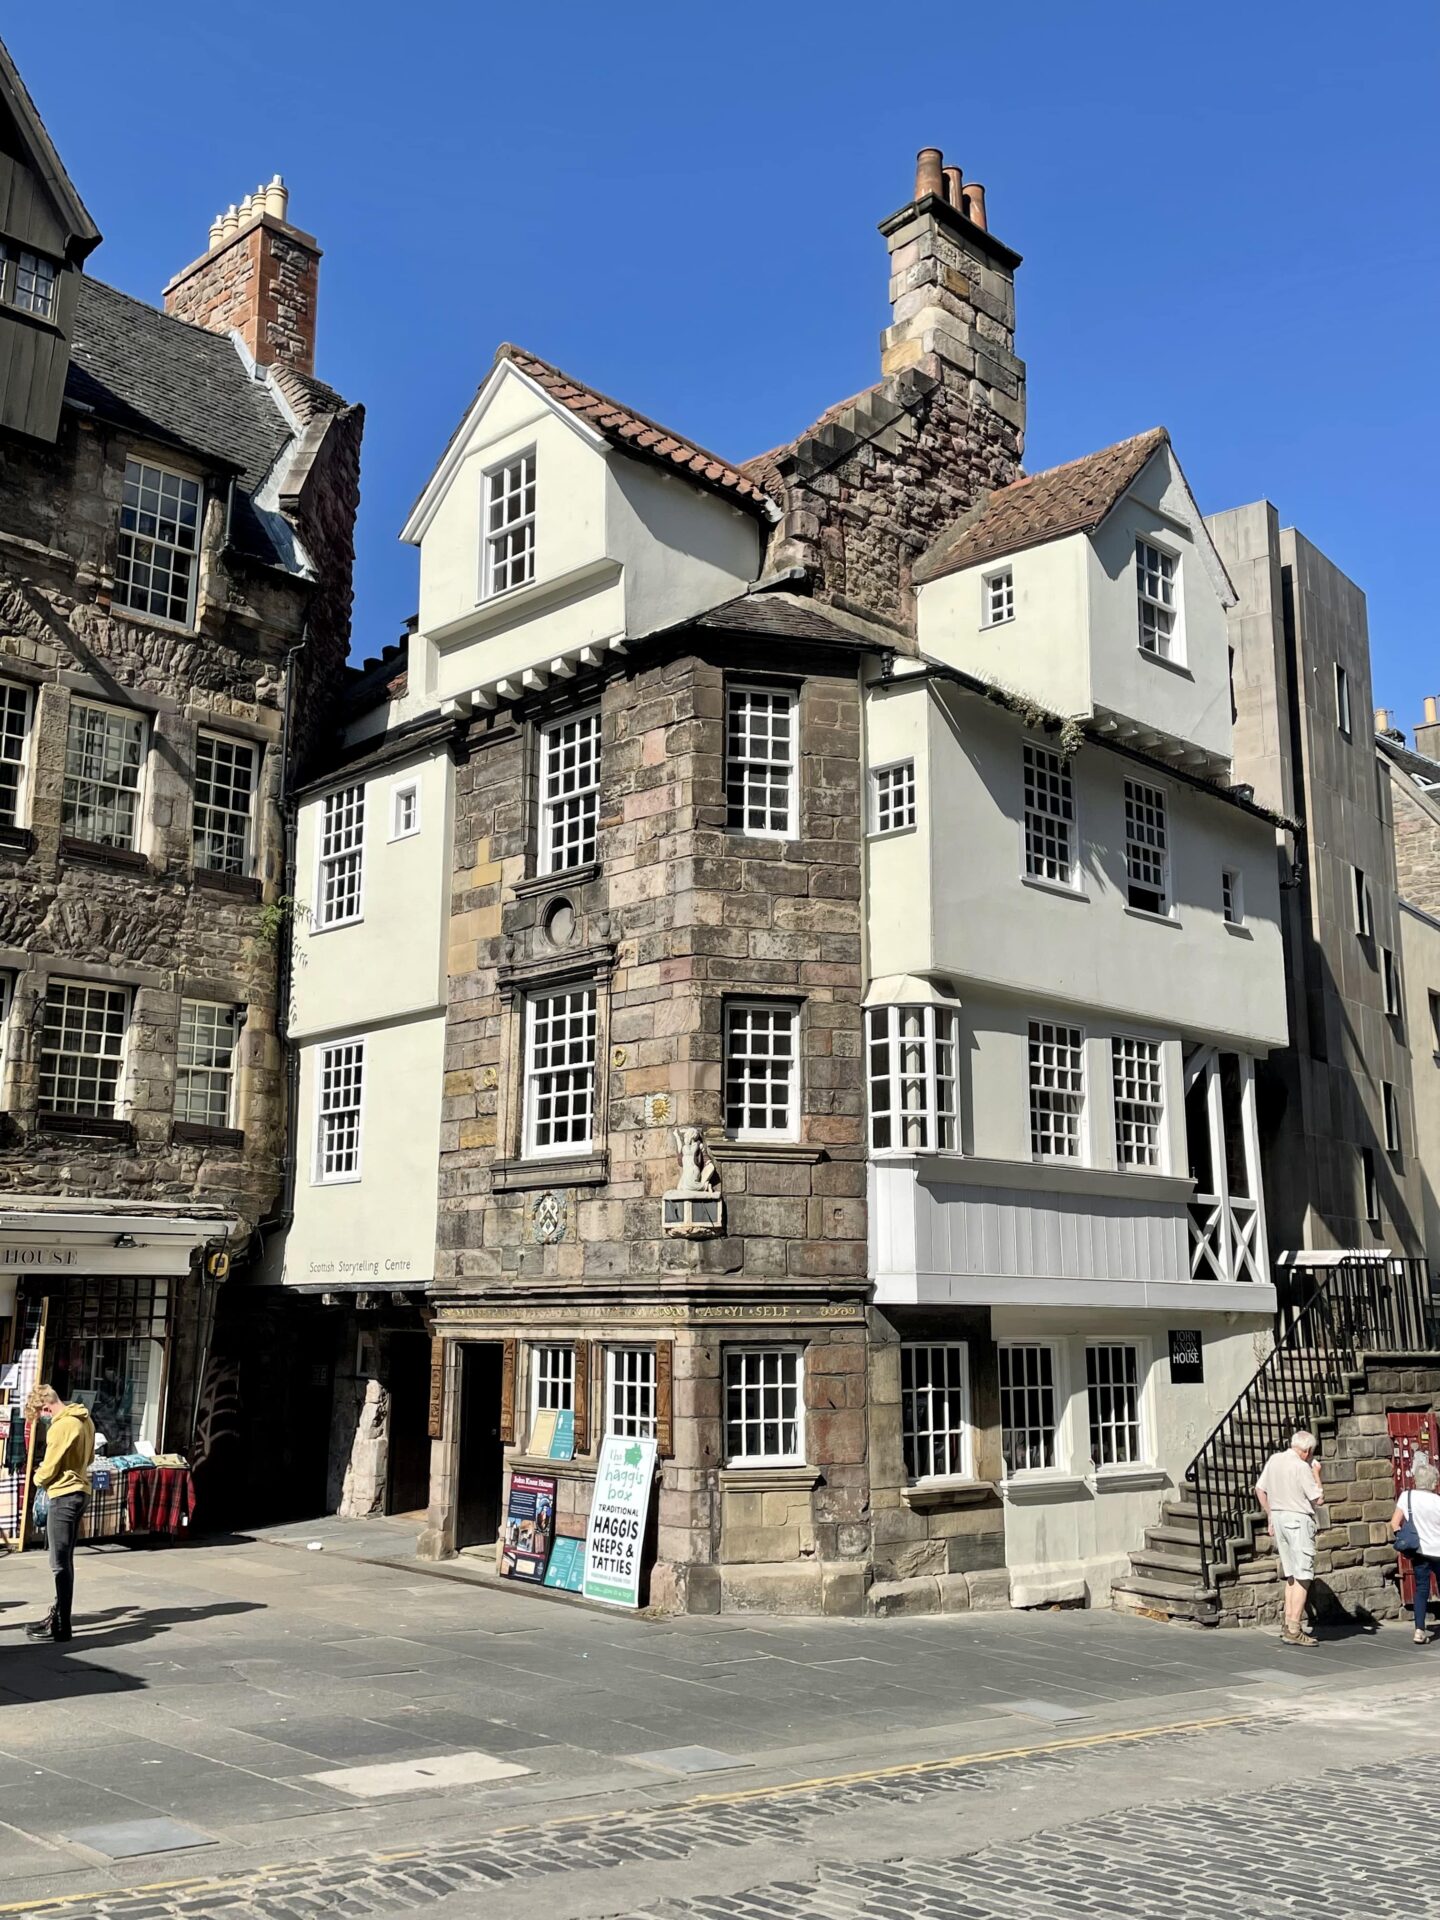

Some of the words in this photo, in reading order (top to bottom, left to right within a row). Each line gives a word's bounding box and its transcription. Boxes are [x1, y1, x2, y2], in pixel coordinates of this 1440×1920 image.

[5, 1249, 79, 1265] HOUSE
[309, 1261, 335, 1273] Scottish
[338, 1260, 379, 1276] Storytelling
[384, 1258, 411, 1271] Centre
[756, 1306, 791, 1317] SELF
[1173, 1341, 1197, 1353] KNOX
[1173, 1352, 1200, 1364] HOUSE
[605, 1463, 644, 1489] haggis
[607, 1483, 632, 1502] box
[598, 1503, 639, 1518] TRADITIONAL
[593, 1515, 639, 1540] HAGGIS
[592, 1537, 623, 1556] NEEPS
[625, 1543, 634, 1558] &
[591, 1555, 632, 1576] TATTIES
